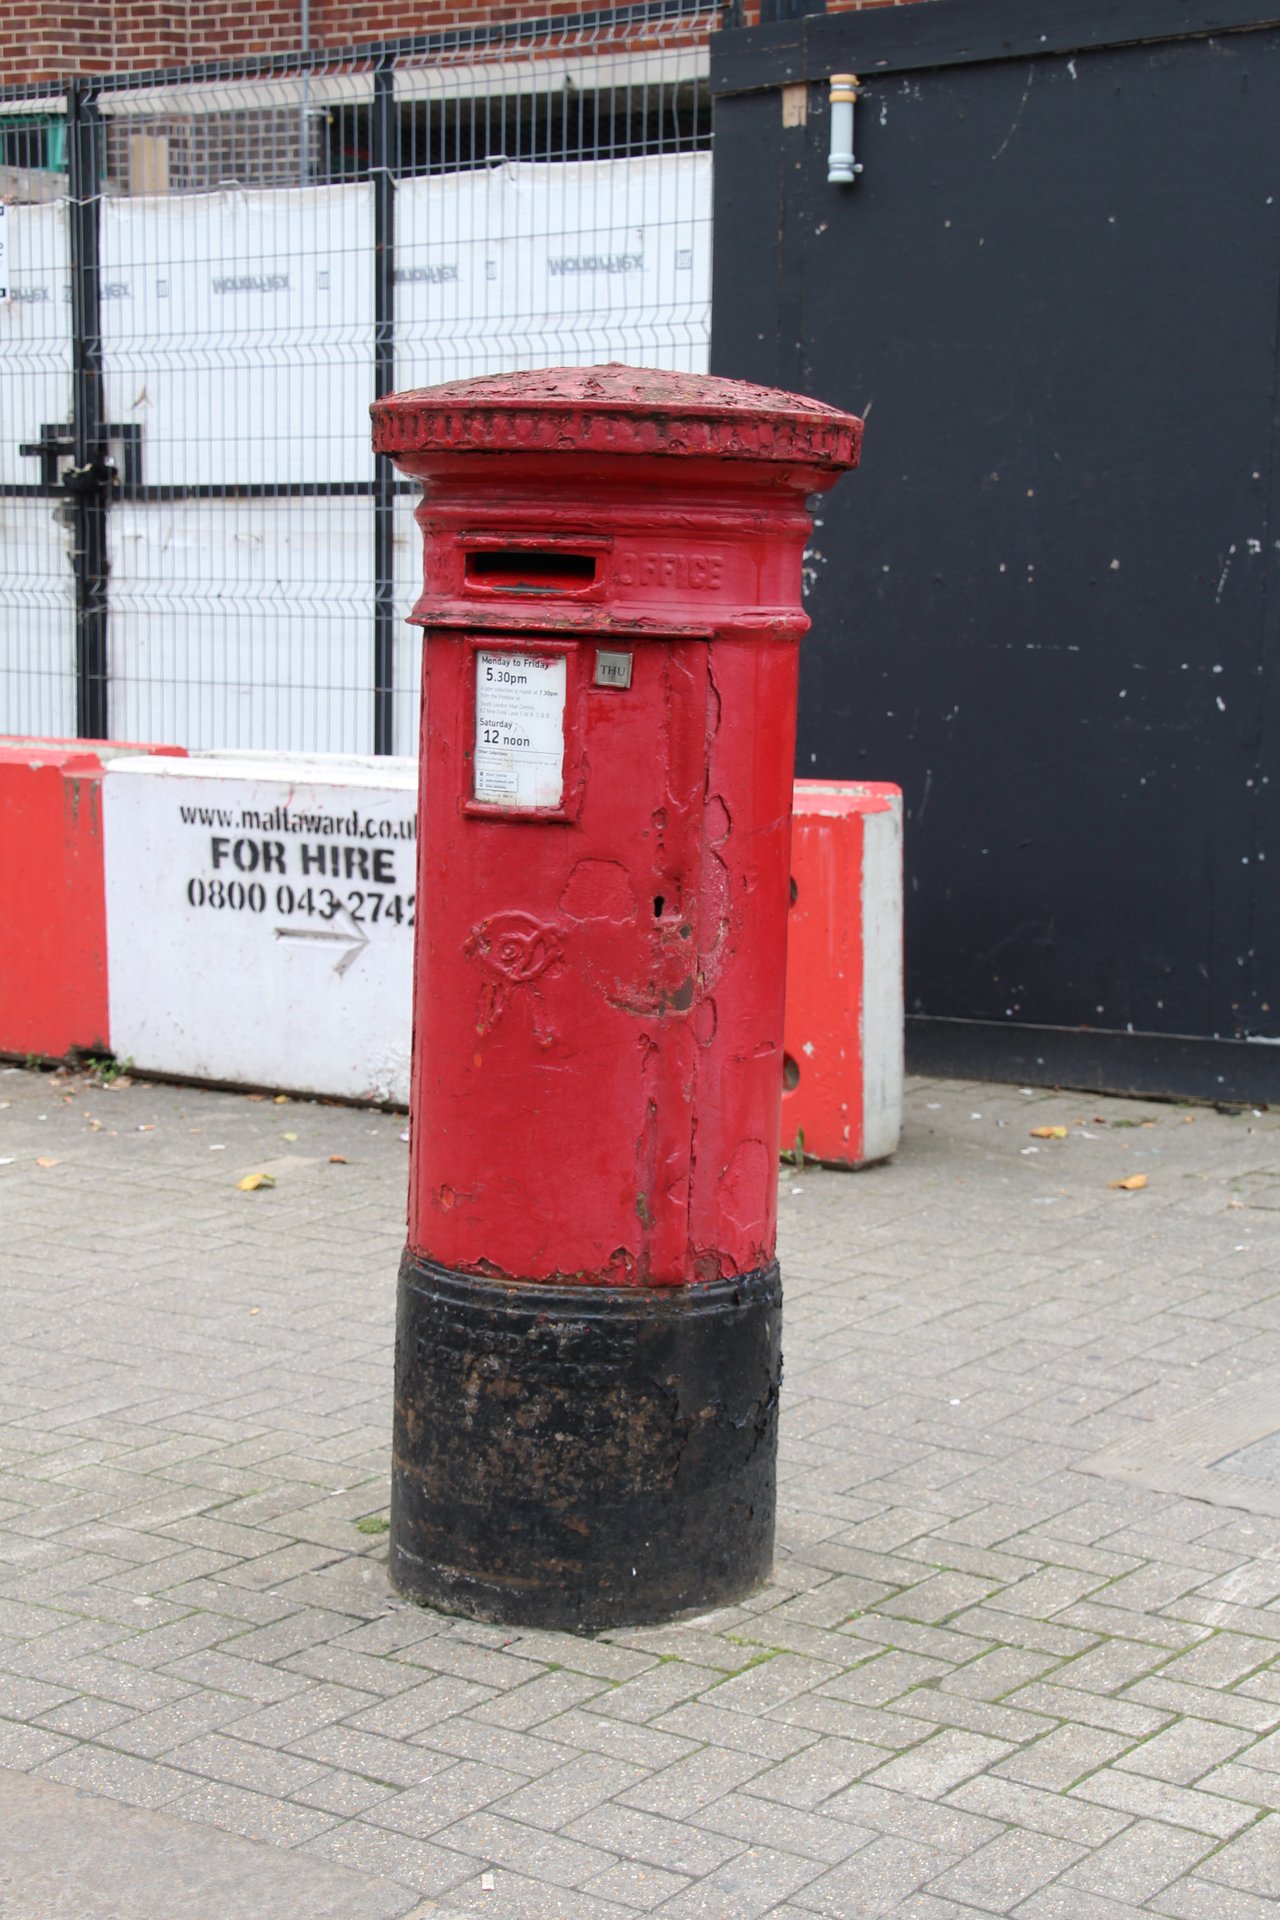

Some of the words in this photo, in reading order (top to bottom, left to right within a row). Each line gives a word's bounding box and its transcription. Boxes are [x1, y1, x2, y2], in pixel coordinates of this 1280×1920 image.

[618, 552, 723, 590] OFFICE
[481, 656, 511, 669] Monday
[513, 658, 521, 667] to
[524, 659, 550, 670] Friday
[600, 665, 626, 677] THU
[486, 668, 528, 686] 5.30pm
[538, 689, 558, 697] 7.30pm
[480, 717, 513, 730] Saturday
[483, 730, 500, 744] 12
[503, 736, 530, 747] noon
[211, 837, 287, 875] FOR
[301, 843, 397, 884] HIRE
[187, 878, 266, 914] 0800
[275, 885, 337, 920] 043
